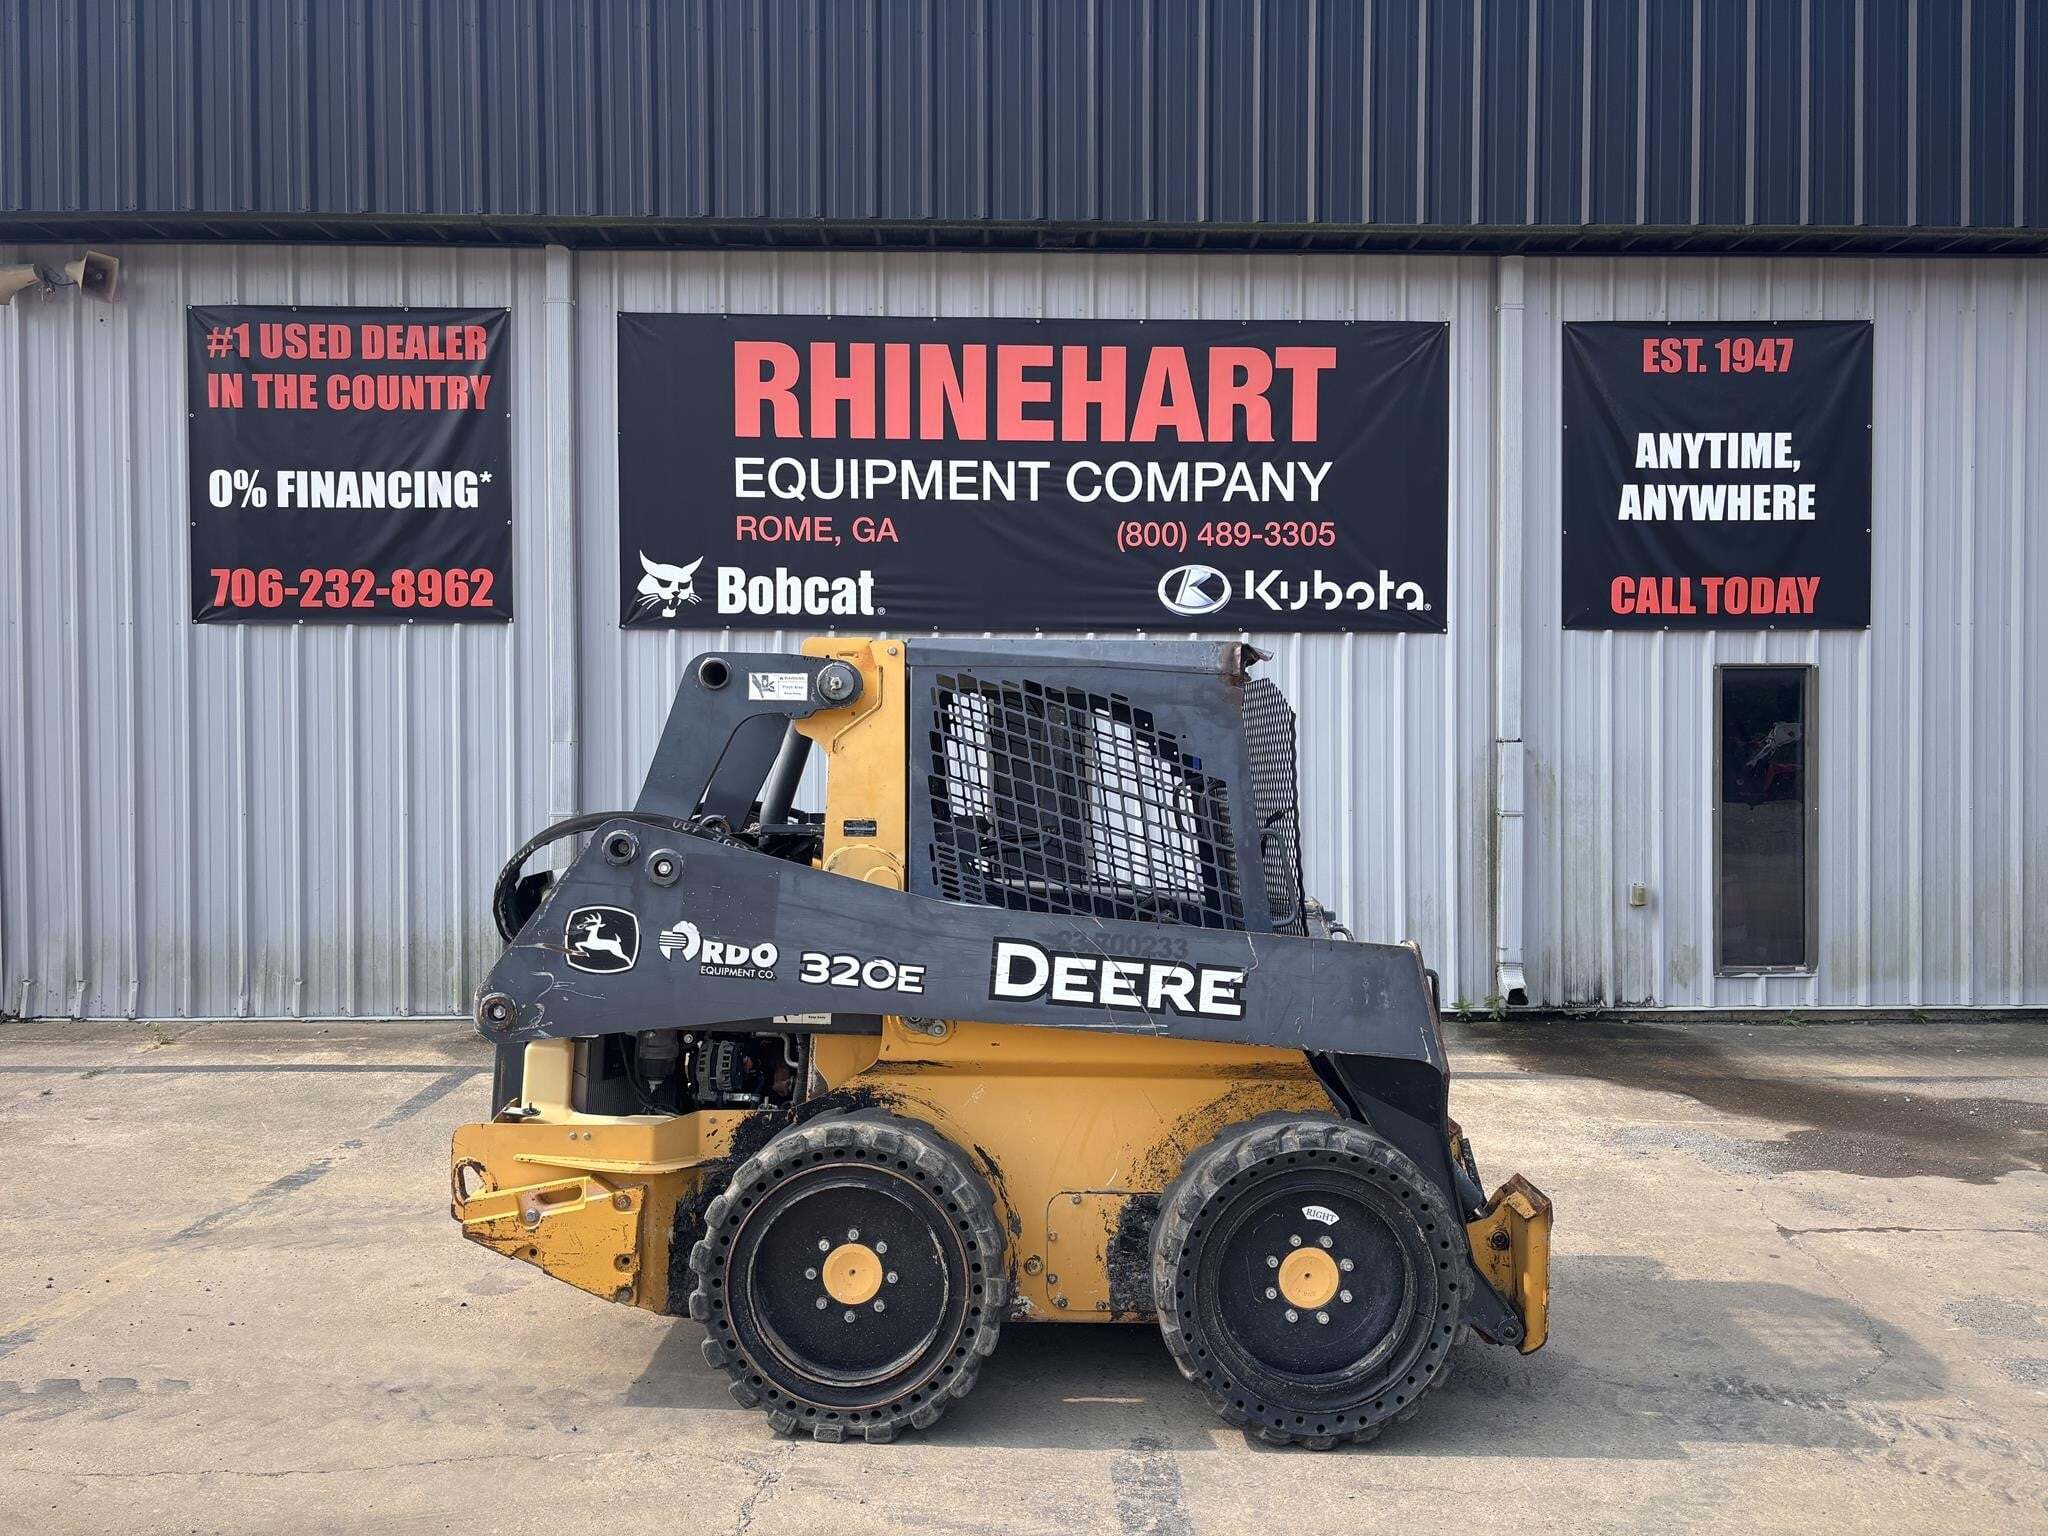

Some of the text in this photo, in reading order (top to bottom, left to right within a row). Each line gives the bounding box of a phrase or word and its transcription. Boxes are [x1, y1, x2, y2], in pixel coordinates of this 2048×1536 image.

[207, 323, 487, 361] #1 USED DEALER
[1643, 338, 1794, 374] EST. 1947
[207, 373, 491, 411] IN THE COUNTRY
[734, 340, 1337, 443] RHINEHART
[1634, 432, 1801, 473] ANYTIME,
[209, 469, 268, 508] 0%
[734, 456, 1333, 503] EQUIPMENT COMPANY
[1617, 483, 1816, 521] ANYWHERE
[736, 515, 899, 547] ROME, GA
[1117, 521, 1336, 553] (800) 489-3305
[210, 568, 494, 608] 706-232-8962
[717, 566, 875, 616] Bobcat
[1244, 569, 1424, 611] Kubota
[1611, 575, 1821, 615] CALL TODAY
[700, 965, 777, 980] EQUIPMENT CO.
[800, 952, 925, 993] 320E
[994, 942, 1244, 1016] DEERE
[1306, 1208, 1336, 1222] RIGHT
